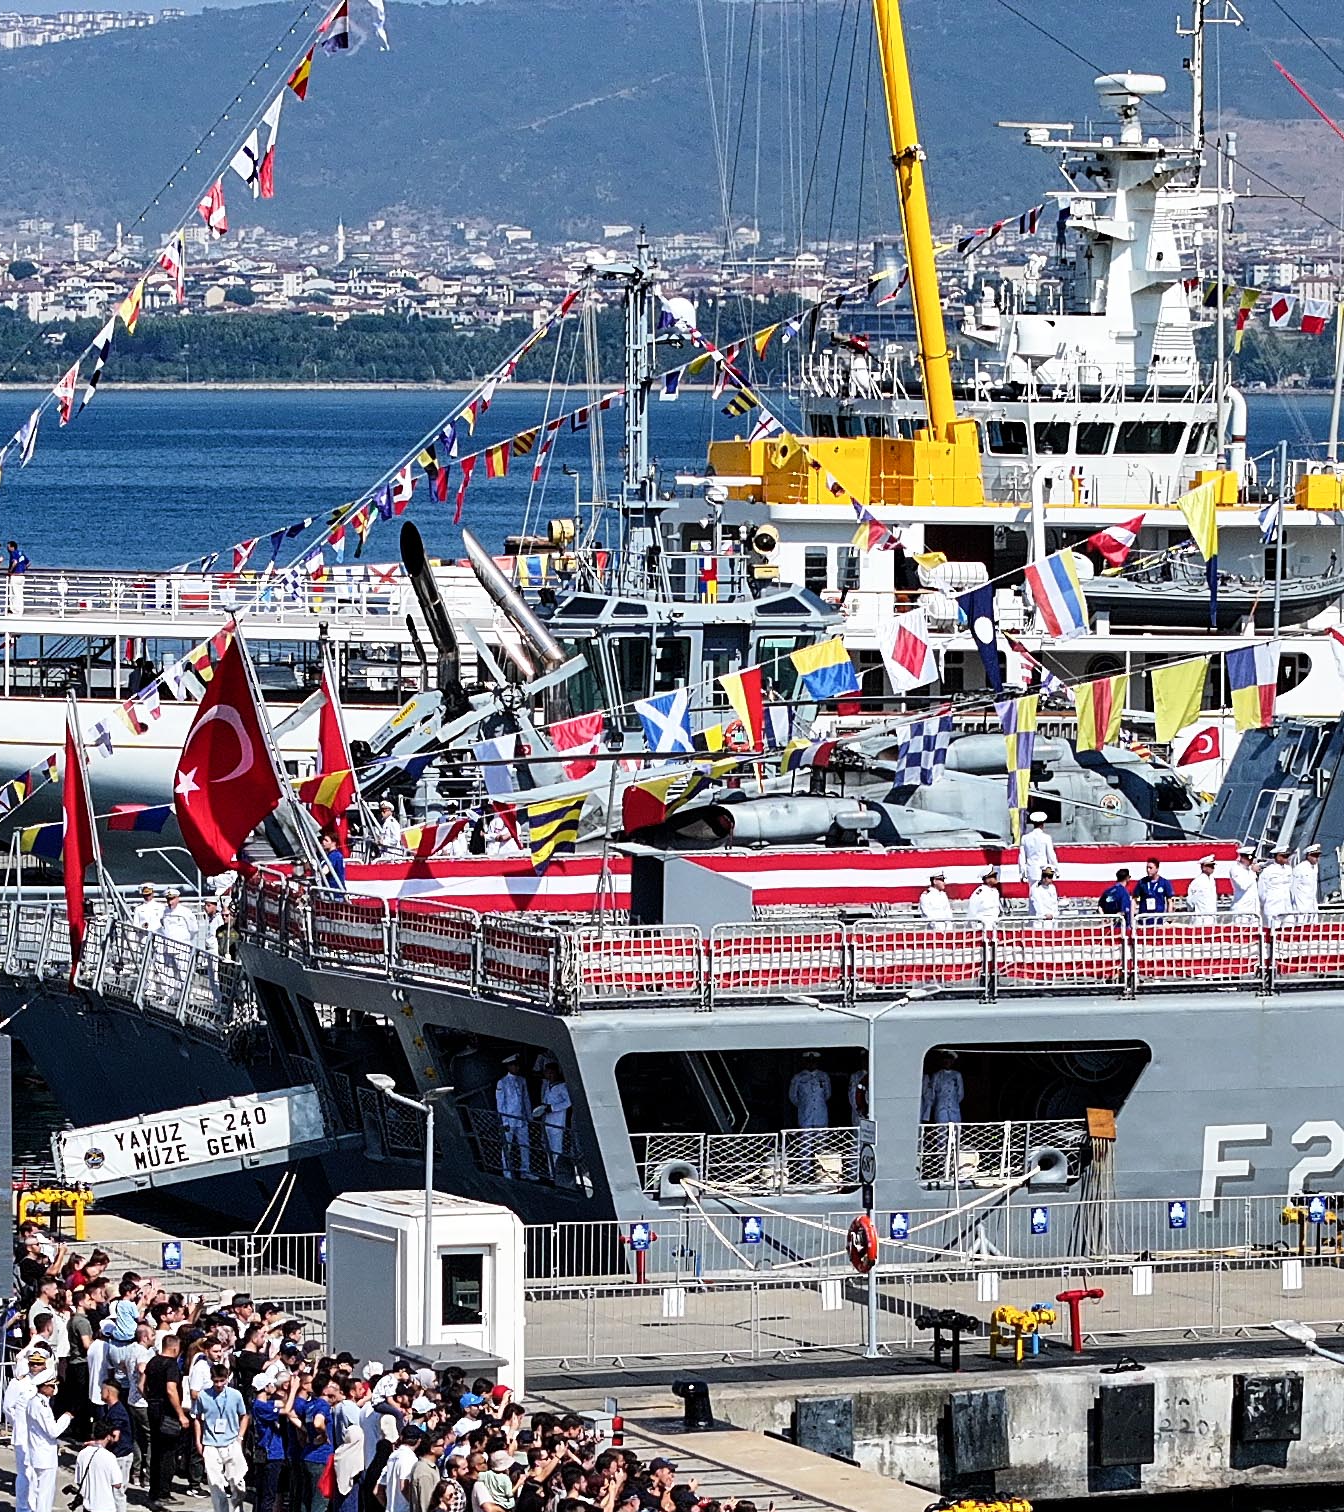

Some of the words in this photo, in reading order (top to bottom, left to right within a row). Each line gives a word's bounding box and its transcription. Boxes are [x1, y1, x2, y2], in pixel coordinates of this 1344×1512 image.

[114, 1123, 180, 1152] YAVUZ
[200, 1116, 210, 1137] F
[223, 1106, 267, 1132] 240
[133, 1141, 191, 1170] MÜZE
[207, 1127, 257, 1157] GEMİ
